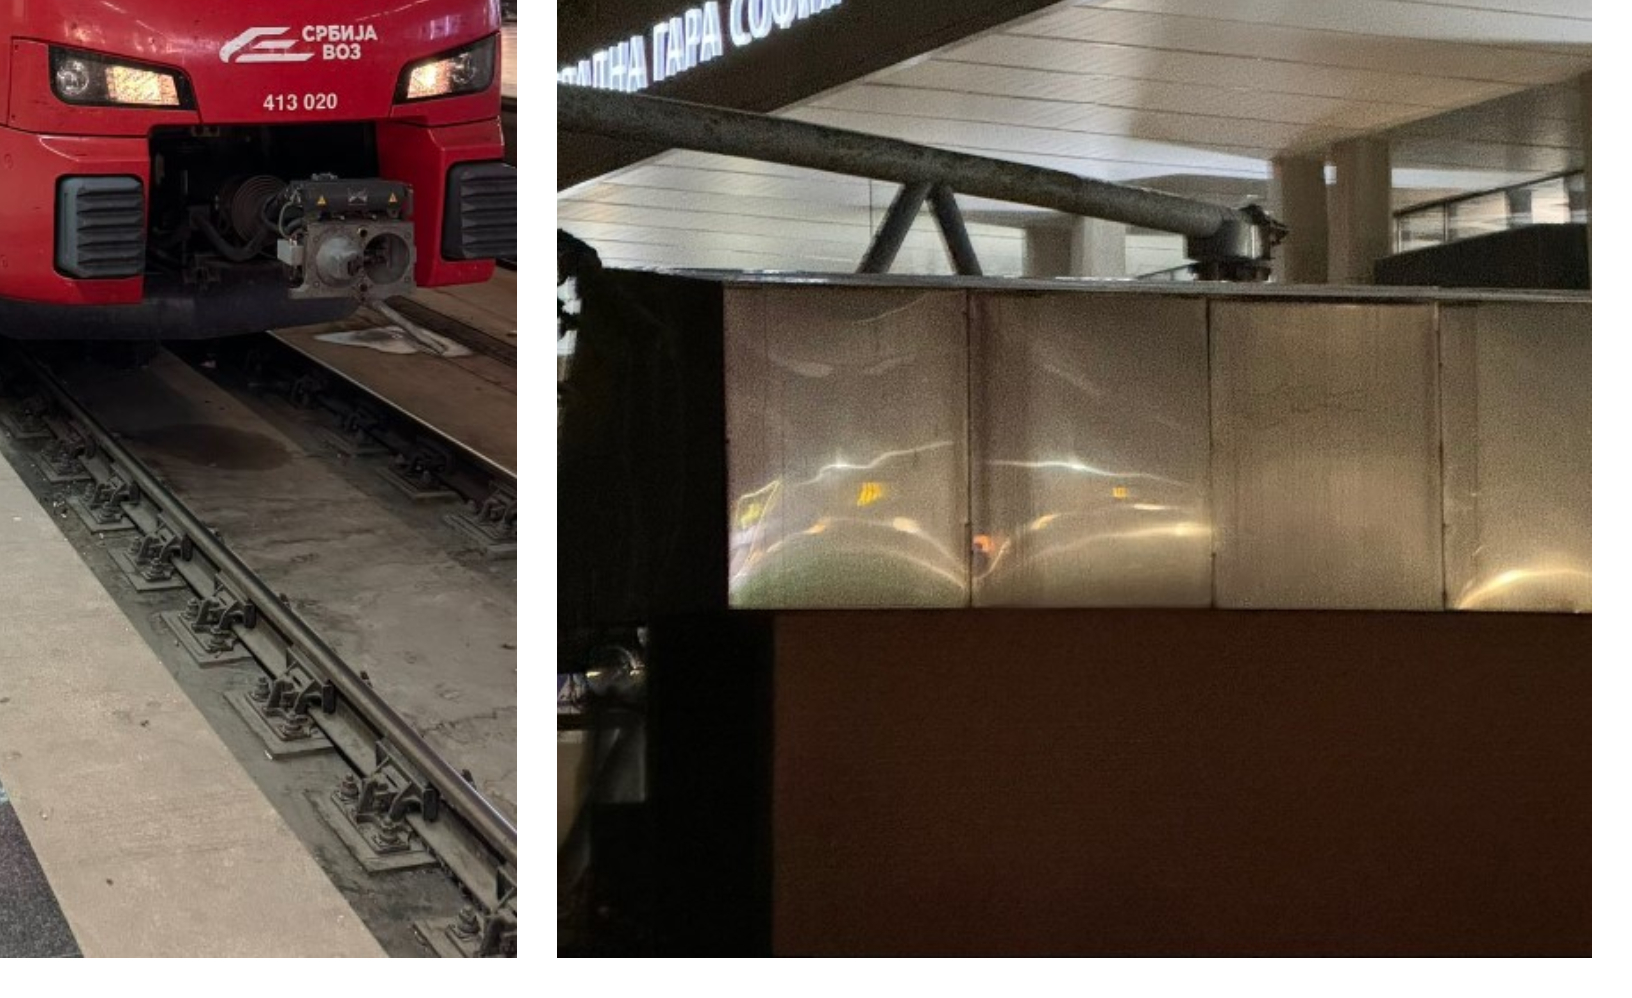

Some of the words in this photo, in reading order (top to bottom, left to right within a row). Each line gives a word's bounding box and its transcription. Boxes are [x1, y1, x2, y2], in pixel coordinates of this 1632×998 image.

[301, 24, 378, 42] СРБИЈА
[652, 0, 723, 82] ГАРА
[322, 43, 361, 60] ВОЗ
[262, 93, 298, 111] 413
[304, 93, 338, 111] 020
